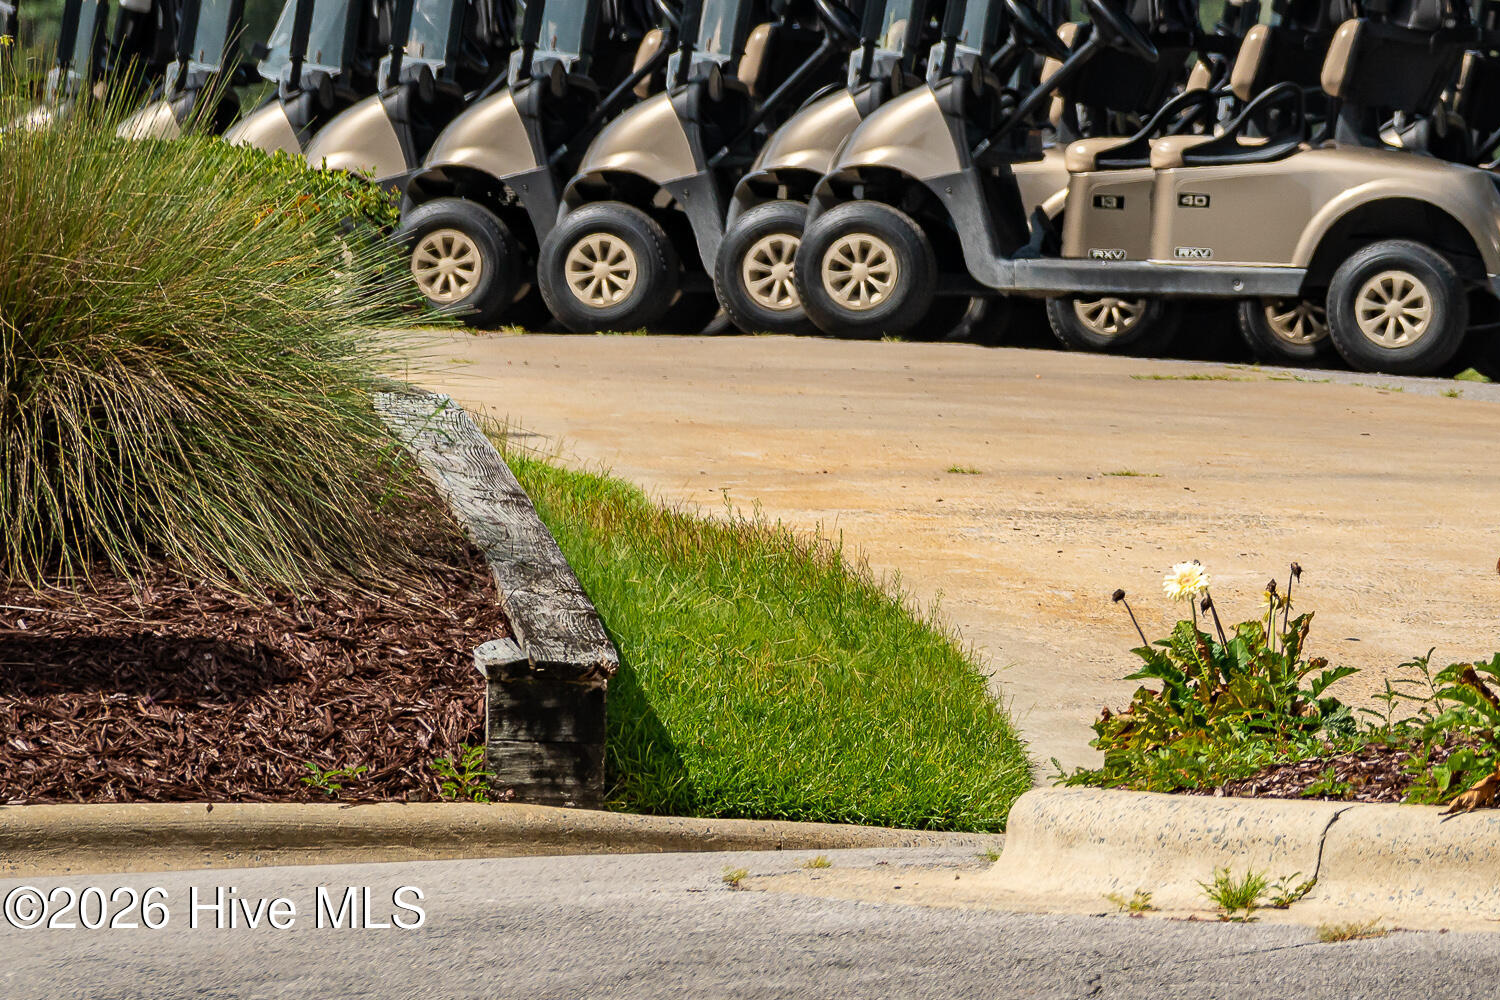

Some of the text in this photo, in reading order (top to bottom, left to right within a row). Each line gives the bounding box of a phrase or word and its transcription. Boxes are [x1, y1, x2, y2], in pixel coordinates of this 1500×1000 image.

[1181, 195, 1208, 207] 40
[1092, 249, 1124, 259] RXV
[1178, 248, 1210, 257] RXV
